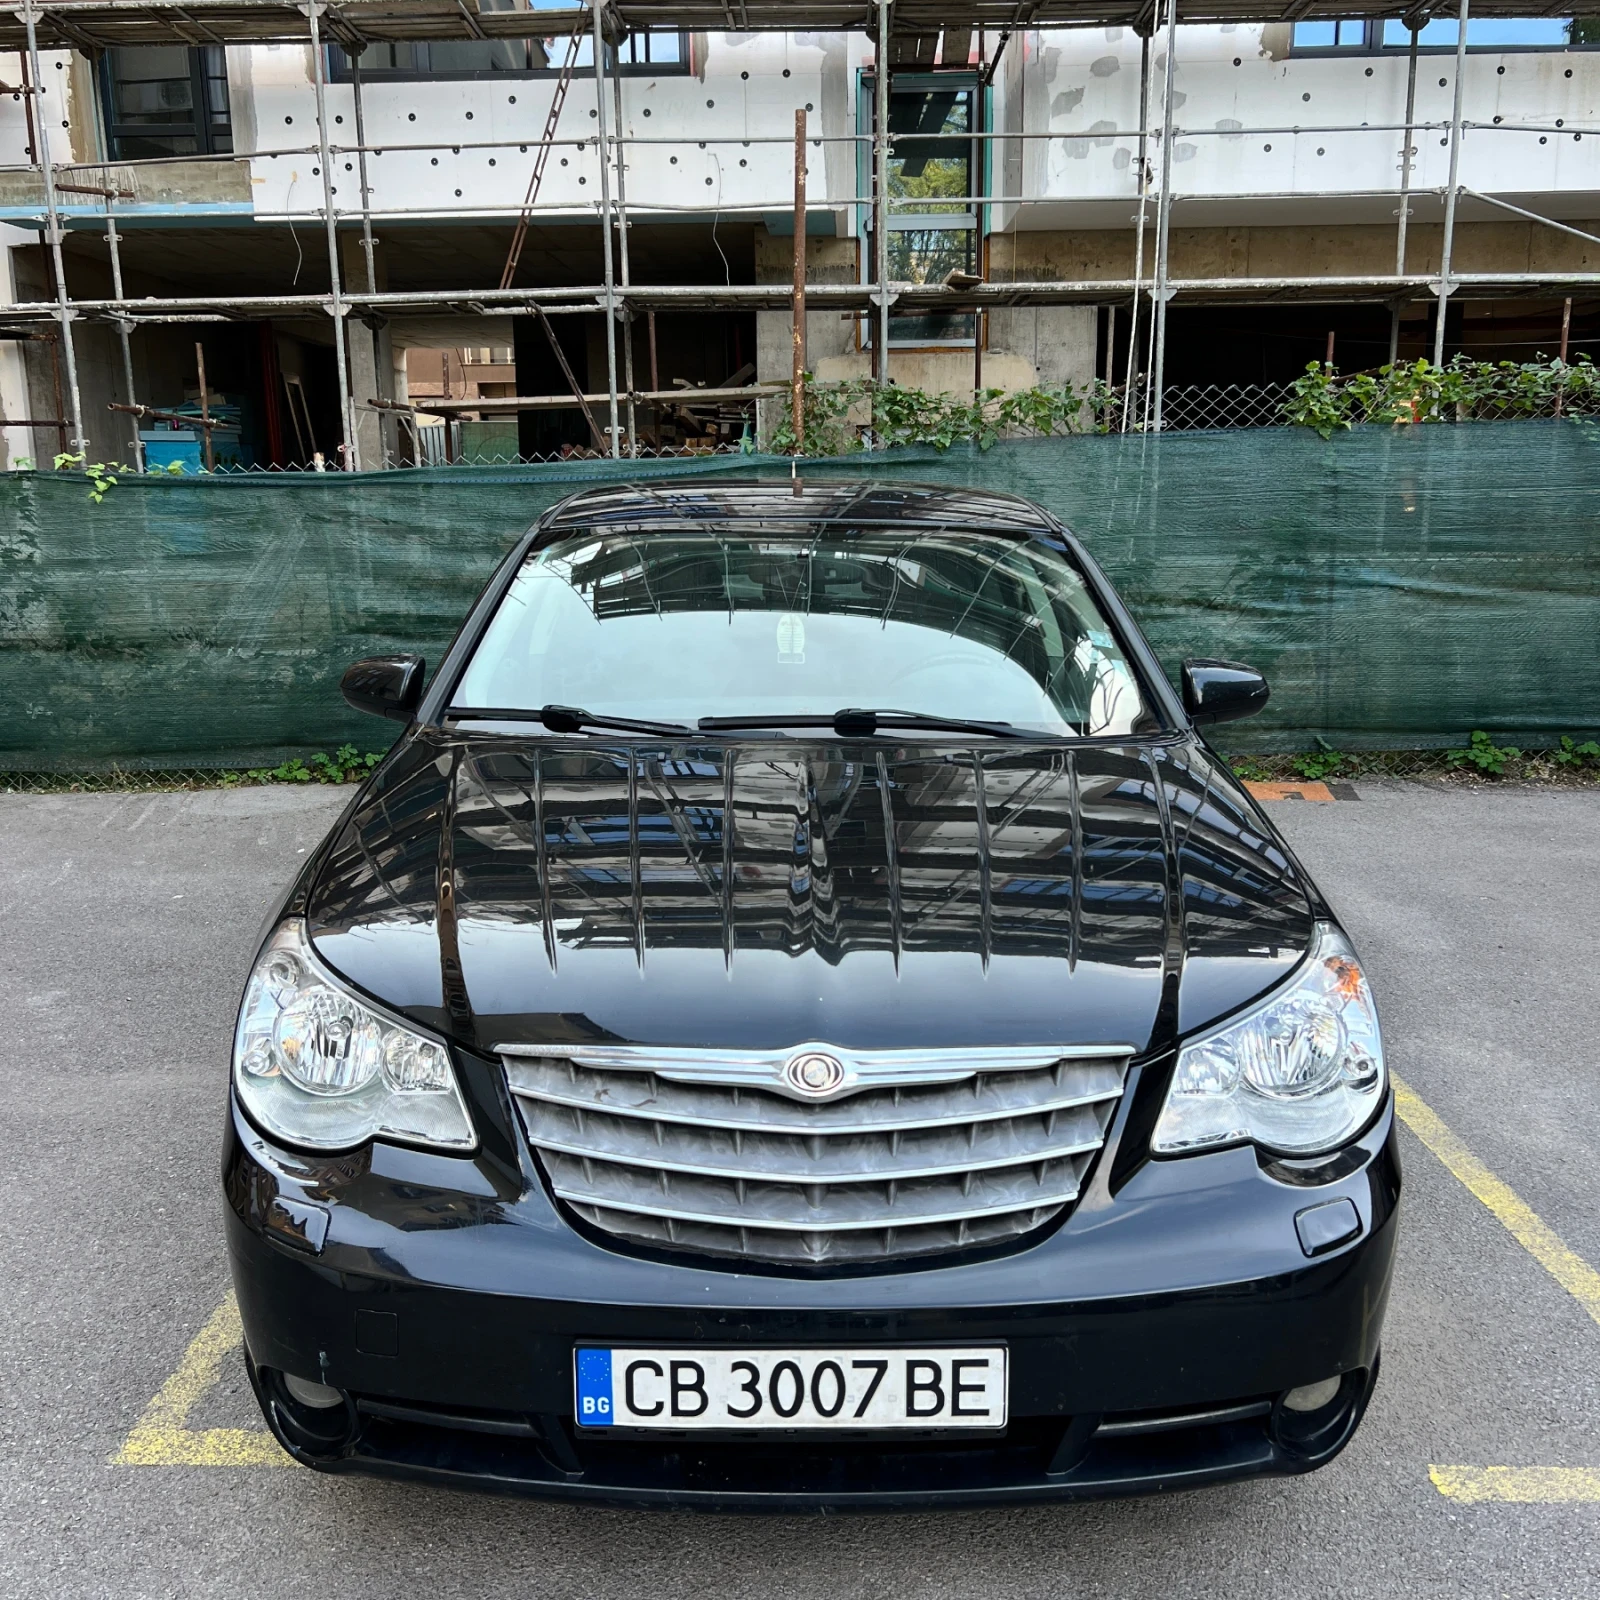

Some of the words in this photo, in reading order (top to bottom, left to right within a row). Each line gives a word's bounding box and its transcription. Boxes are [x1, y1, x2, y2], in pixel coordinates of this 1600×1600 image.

[583, 1396, 610, 1414] BG
[625, 1360, 709, 1418] CB
[727, 1360, 889, 1419] 3007
[906, 1359, 991, 1418] BE
